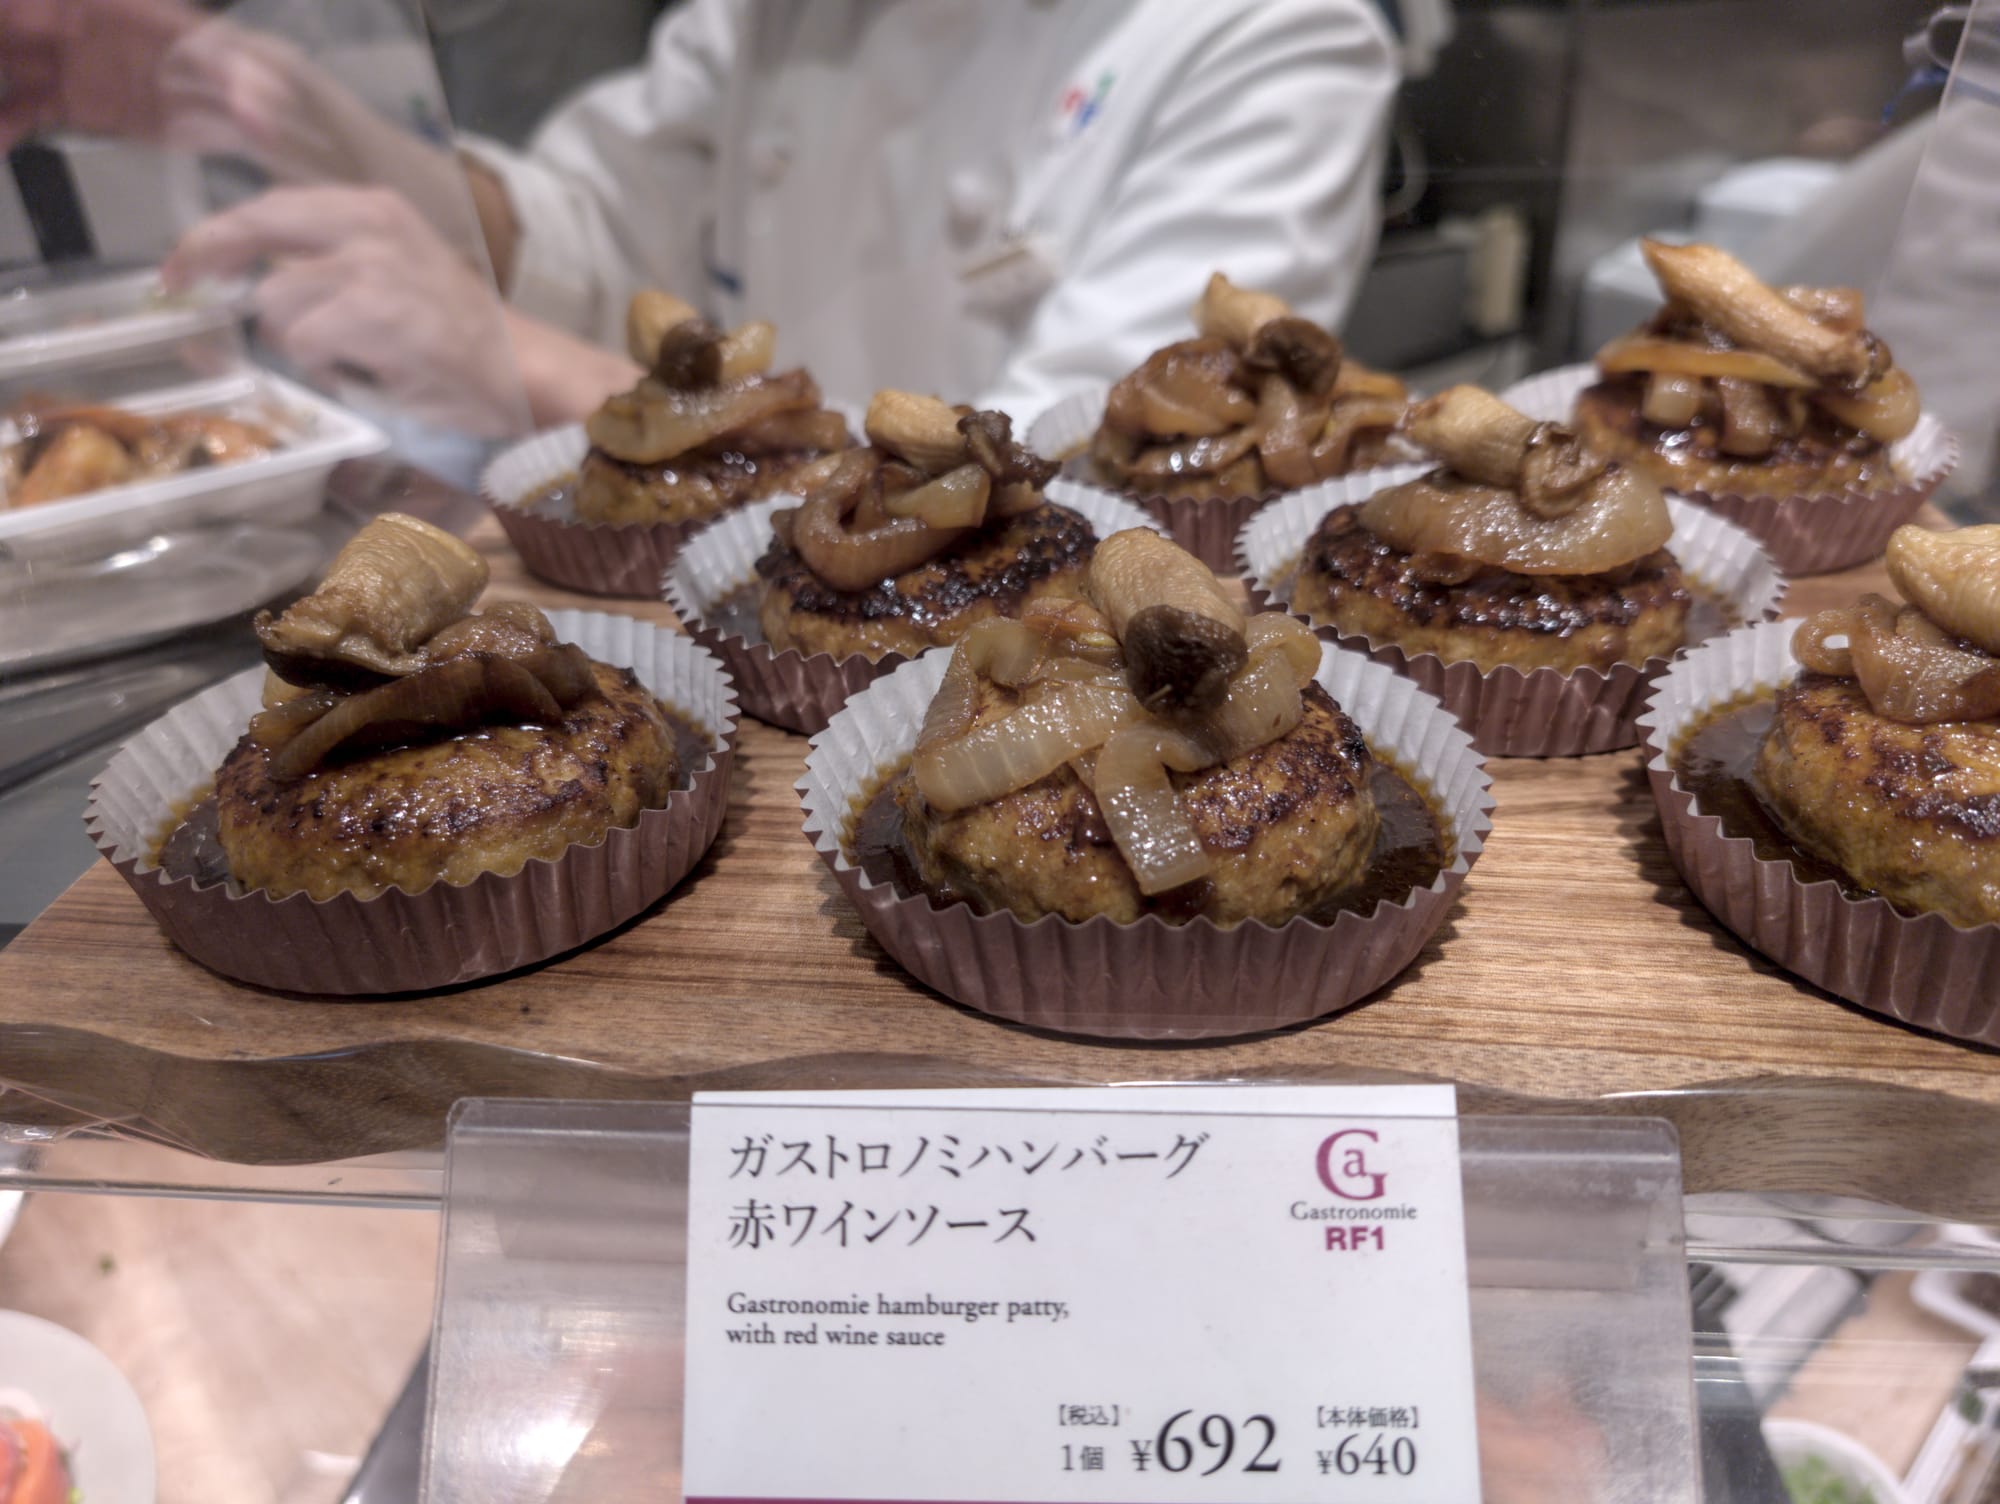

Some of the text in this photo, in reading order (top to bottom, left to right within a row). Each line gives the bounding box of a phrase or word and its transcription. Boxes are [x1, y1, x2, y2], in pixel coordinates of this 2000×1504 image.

[730, 1133, 1209, 1180] ガストロノミハンバーグ
[729, 1199, 1036, 1250] 赤ワインソース
[1291, 1201, 1418, 1220] Gastronomie
[1326, 1227, 1384, 1251] RF1
[727, 1293, 1069, 1323] Gastronomie hamburger patty,
[727, 1322, 945, 1346] with red wine sauce
[1130, 1409, 1281, 1477] ¥692
[1317, 1433, 1417, 1476] ¥640
